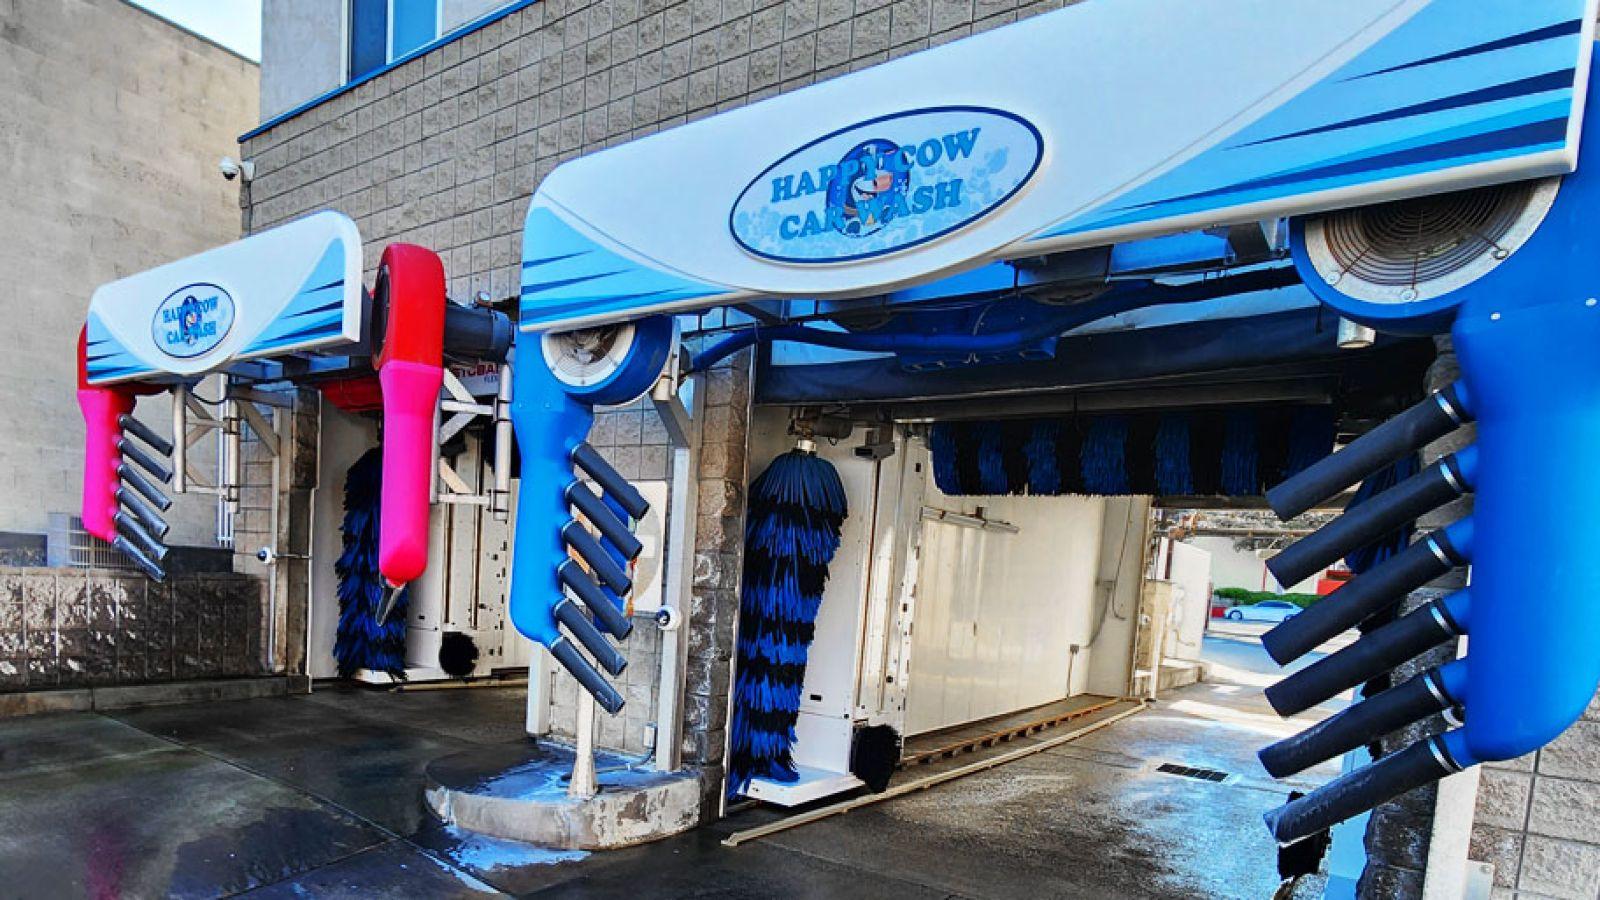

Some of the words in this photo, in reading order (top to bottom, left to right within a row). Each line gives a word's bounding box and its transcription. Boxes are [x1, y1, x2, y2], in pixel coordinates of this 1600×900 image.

[771, 153, 882, 203] HAPPY
[894, 127, 981, 172] COW
[780, 207, 846, 240] CAR
[856, 179, 963, 226] WASH
